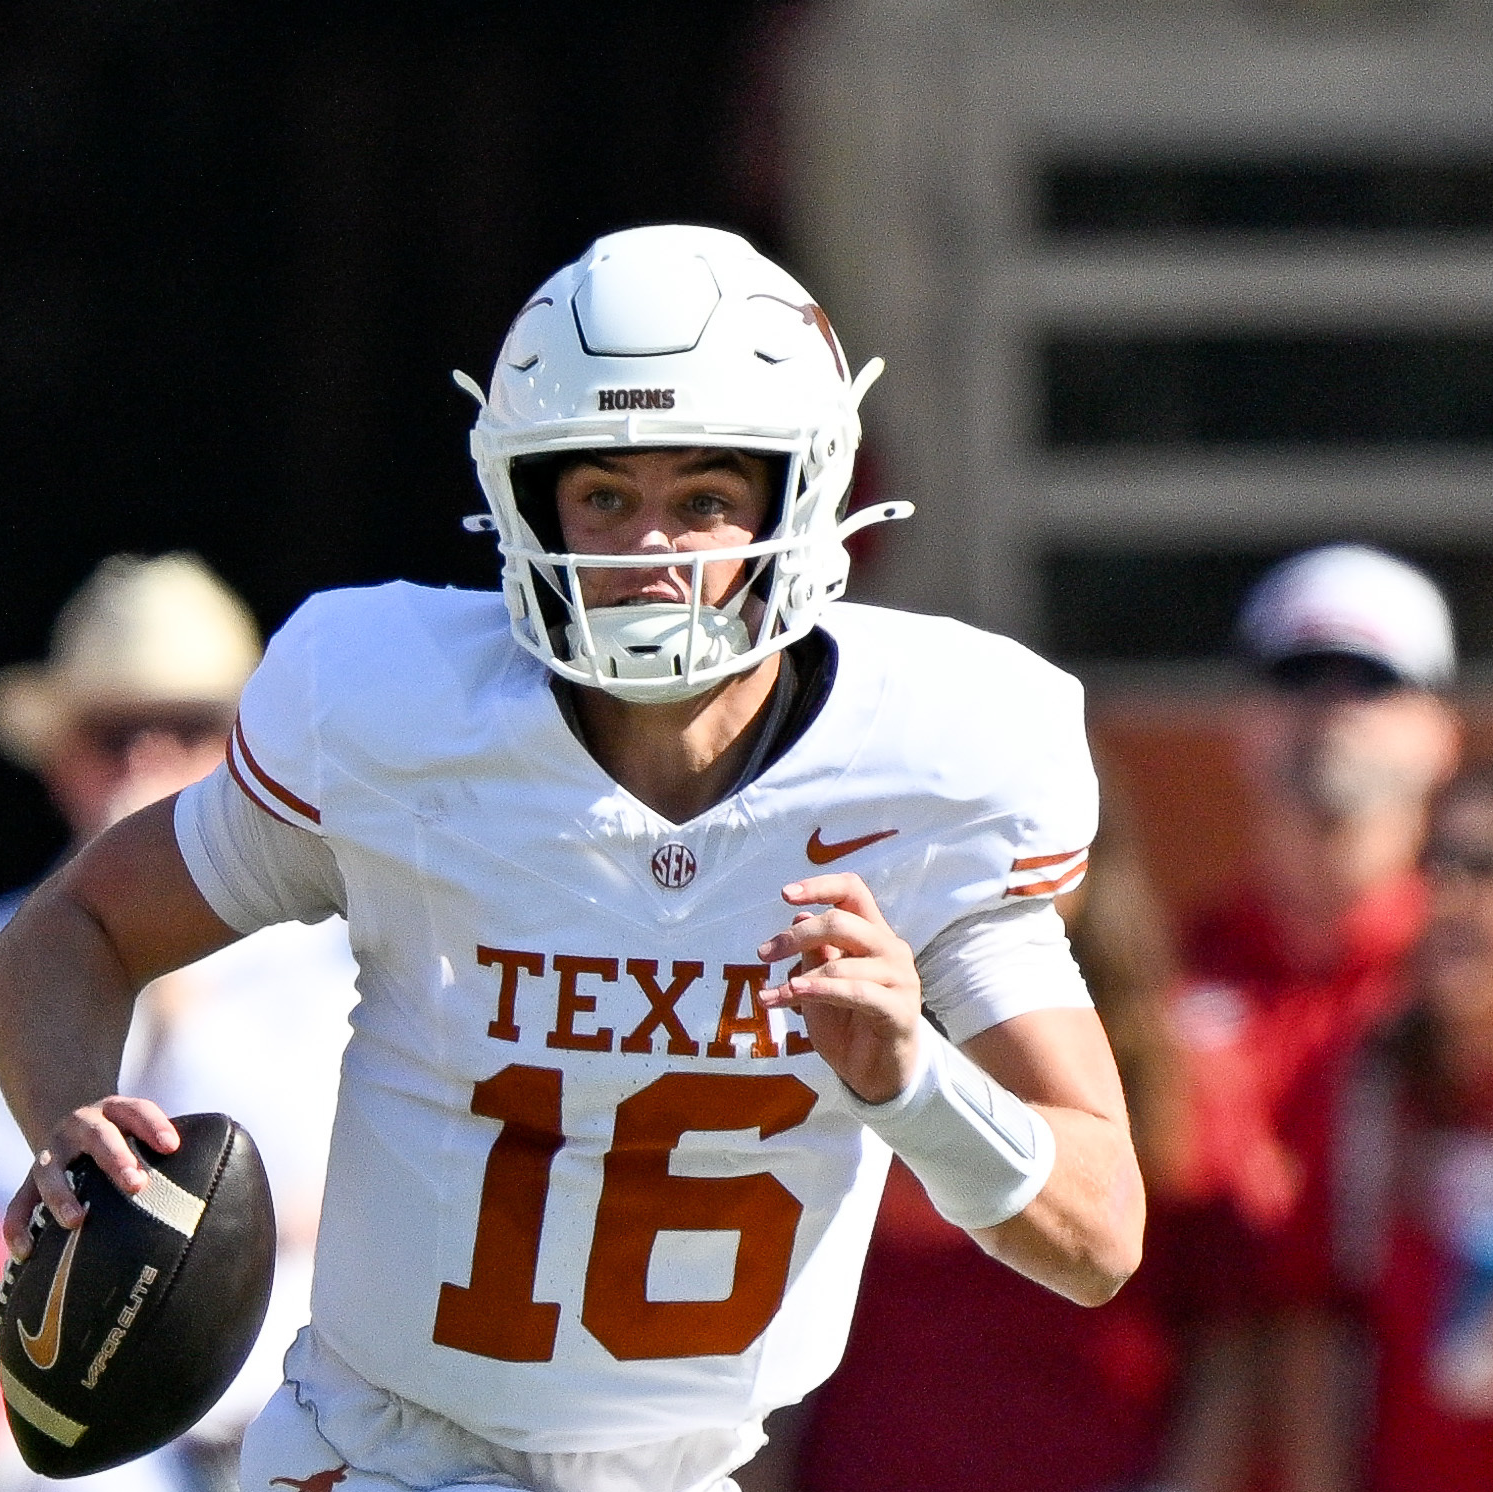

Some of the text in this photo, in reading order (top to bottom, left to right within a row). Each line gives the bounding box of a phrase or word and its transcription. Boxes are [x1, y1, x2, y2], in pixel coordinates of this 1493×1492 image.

[598, 388, 675, 411] HORNS
[652, 845, 696, 887] SEC
[433, 1063, 819, 1363] 16
[81, 1264, 159, 1390] VAPOR ELITE
